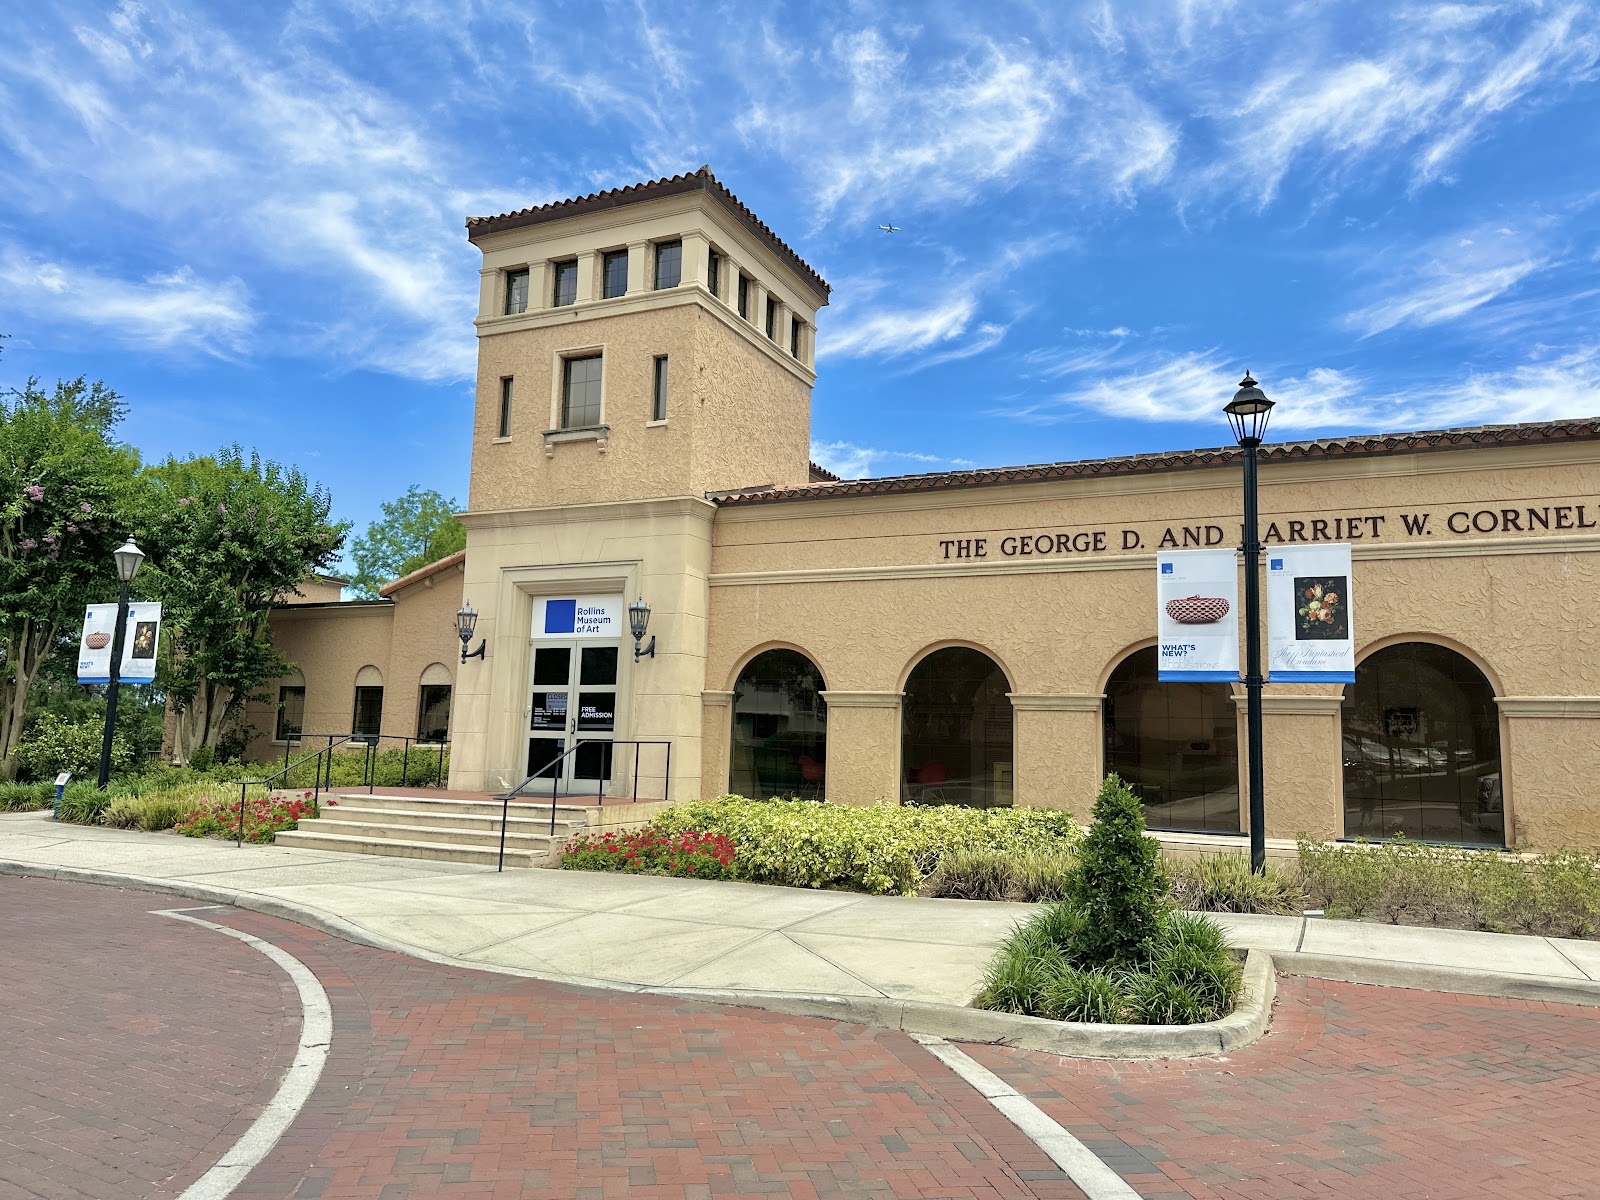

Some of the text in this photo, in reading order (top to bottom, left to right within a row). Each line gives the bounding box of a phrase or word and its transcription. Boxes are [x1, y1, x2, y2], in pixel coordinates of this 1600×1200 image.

[940, 538, 987, 559] THE
[1000, 531, 1107, 556] GEORGE
[1121, 530, 1145, 549] D.
[1158, 525, 1224, 548] AND
[1400, 513, 1432, 536] W.
[1447, 504, 1600, 534] CORNEL
[577, 607, 605, 616] Rollins
[577, 616, 611, 624] Museum
[576, 625, 600, 633] of Art
[1300, 643, 1351, 658] Fantastical
